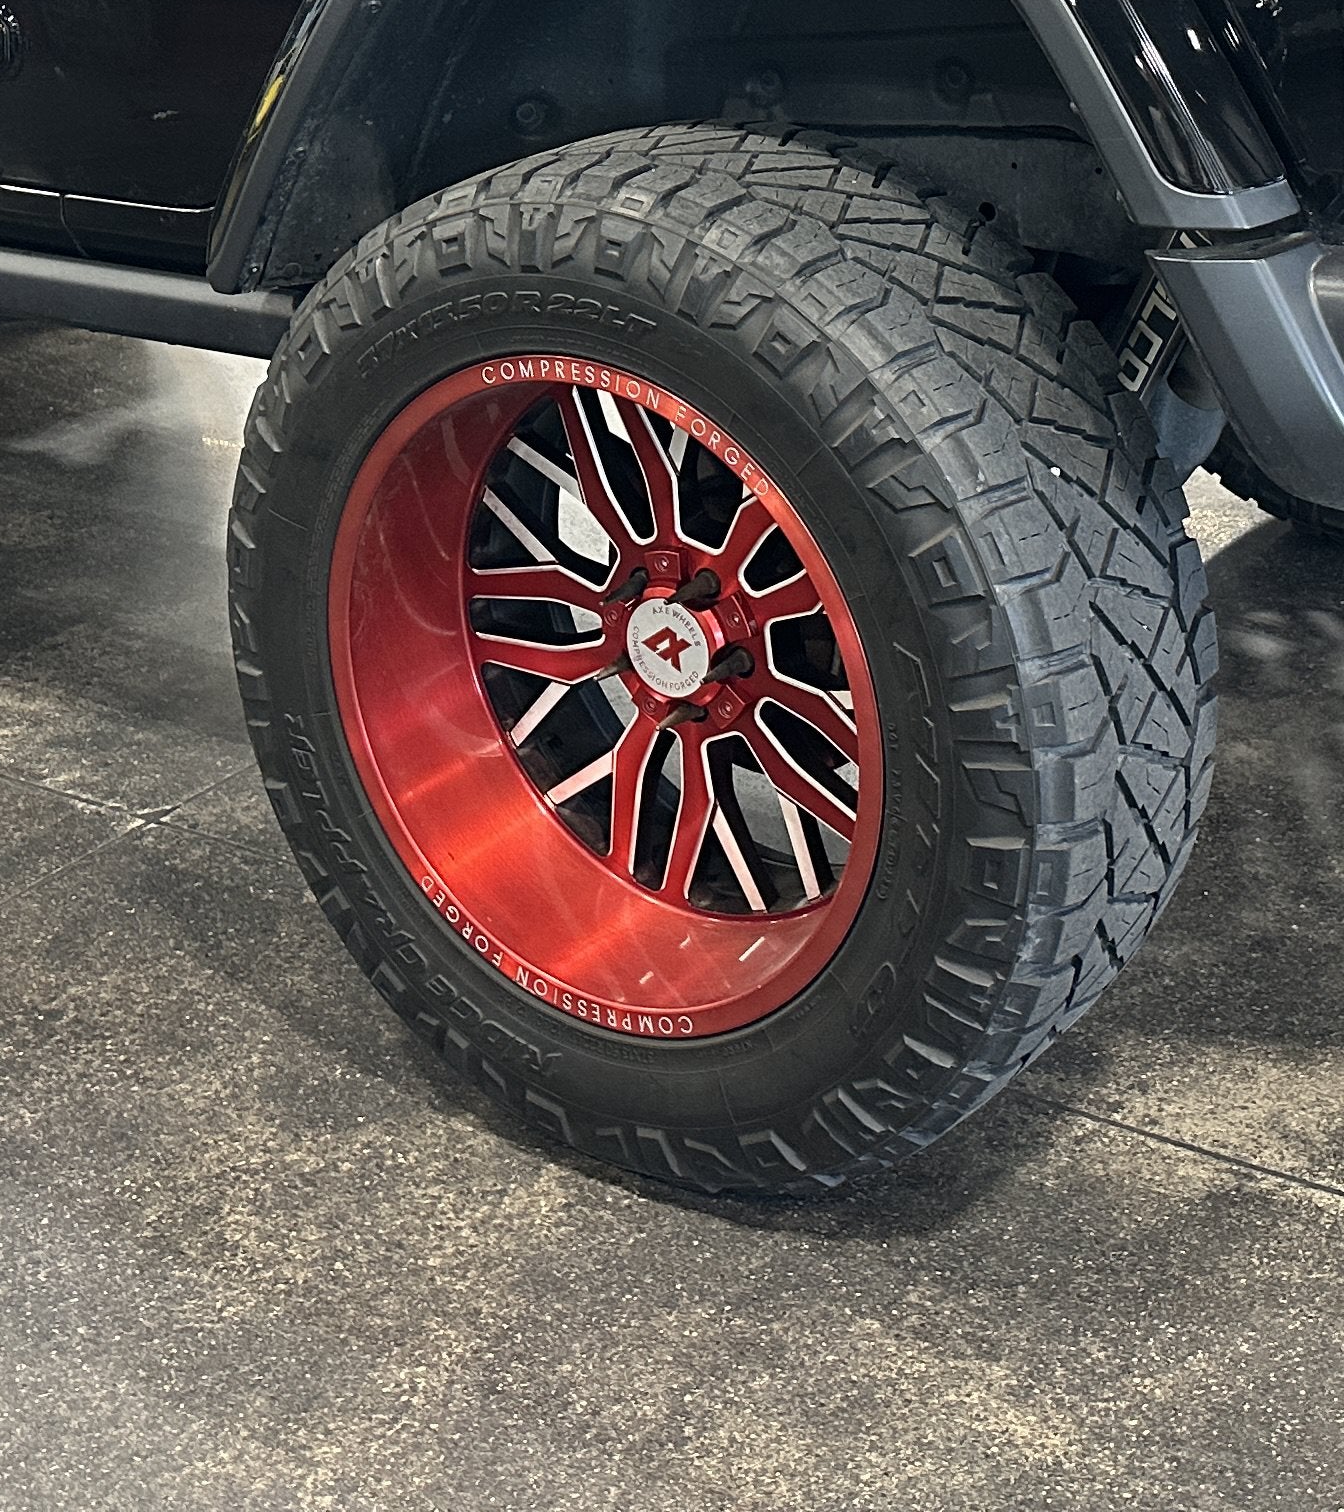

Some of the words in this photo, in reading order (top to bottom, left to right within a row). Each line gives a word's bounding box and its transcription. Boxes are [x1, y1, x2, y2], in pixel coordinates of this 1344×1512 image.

[480, 358, 661, 410] COMPRESSION
[673, 405, 771, 498] FORGED
[651, 606, 671, 617] AXE
[671, 608, 702, 648] WHEELS
[420, 873, 504, 969] FORGED
[514, 964, 695, 1035] COMPRESSION
